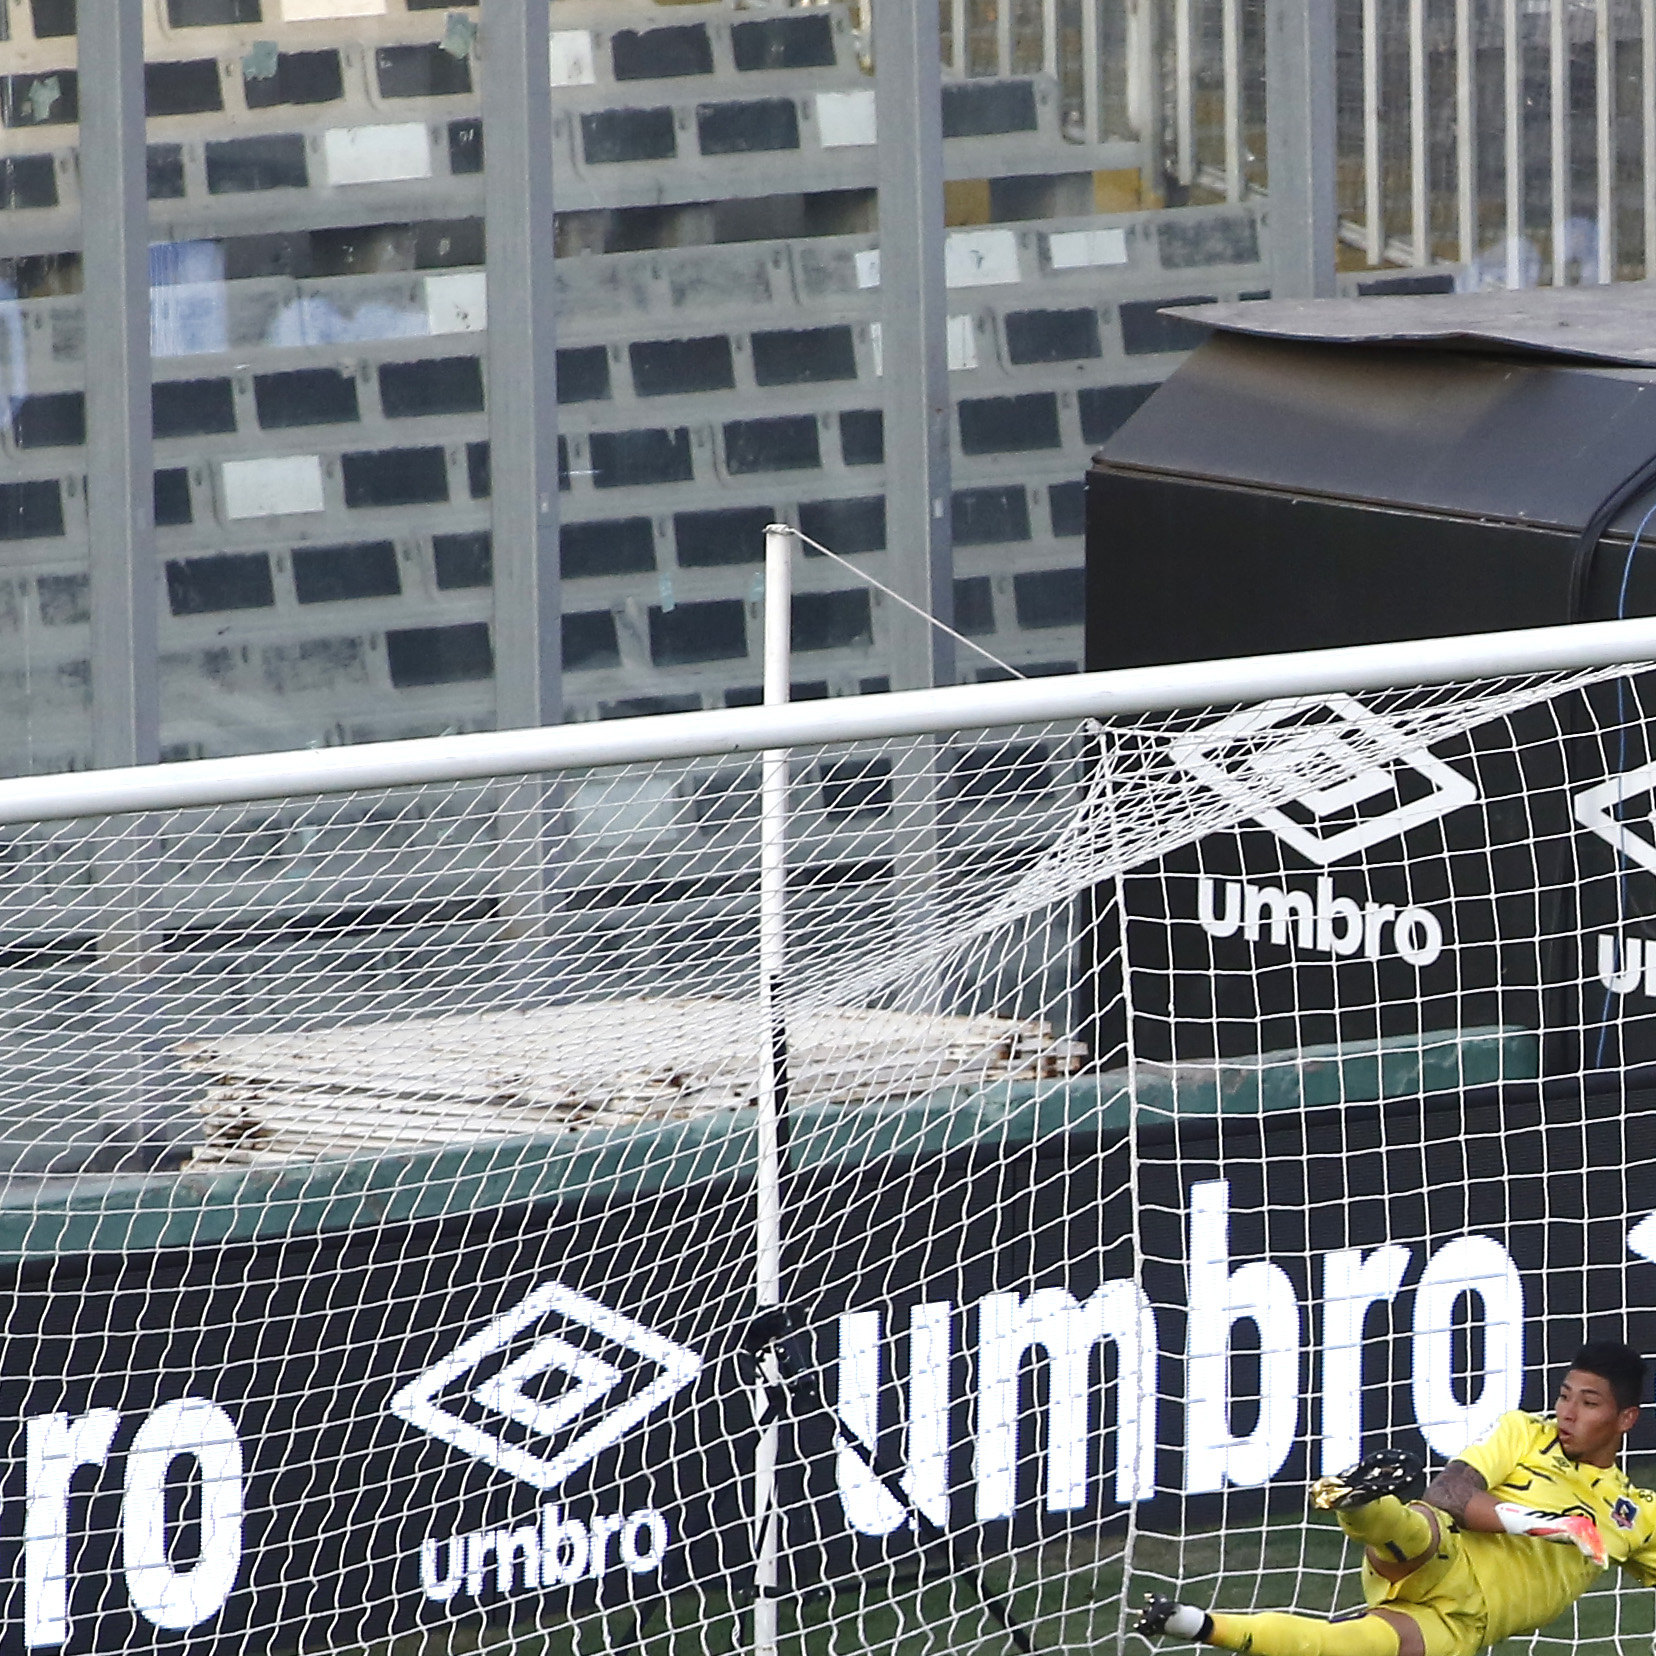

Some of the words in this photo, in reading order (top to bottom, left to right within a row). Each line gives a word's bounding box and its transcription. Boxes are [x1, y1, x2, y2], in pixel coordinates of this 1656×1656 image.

[1201, 876, 1442, 966] umbro
[836, 1178, 1526, 1536] umbro
[419, 1504, 668, 1602] umbro
